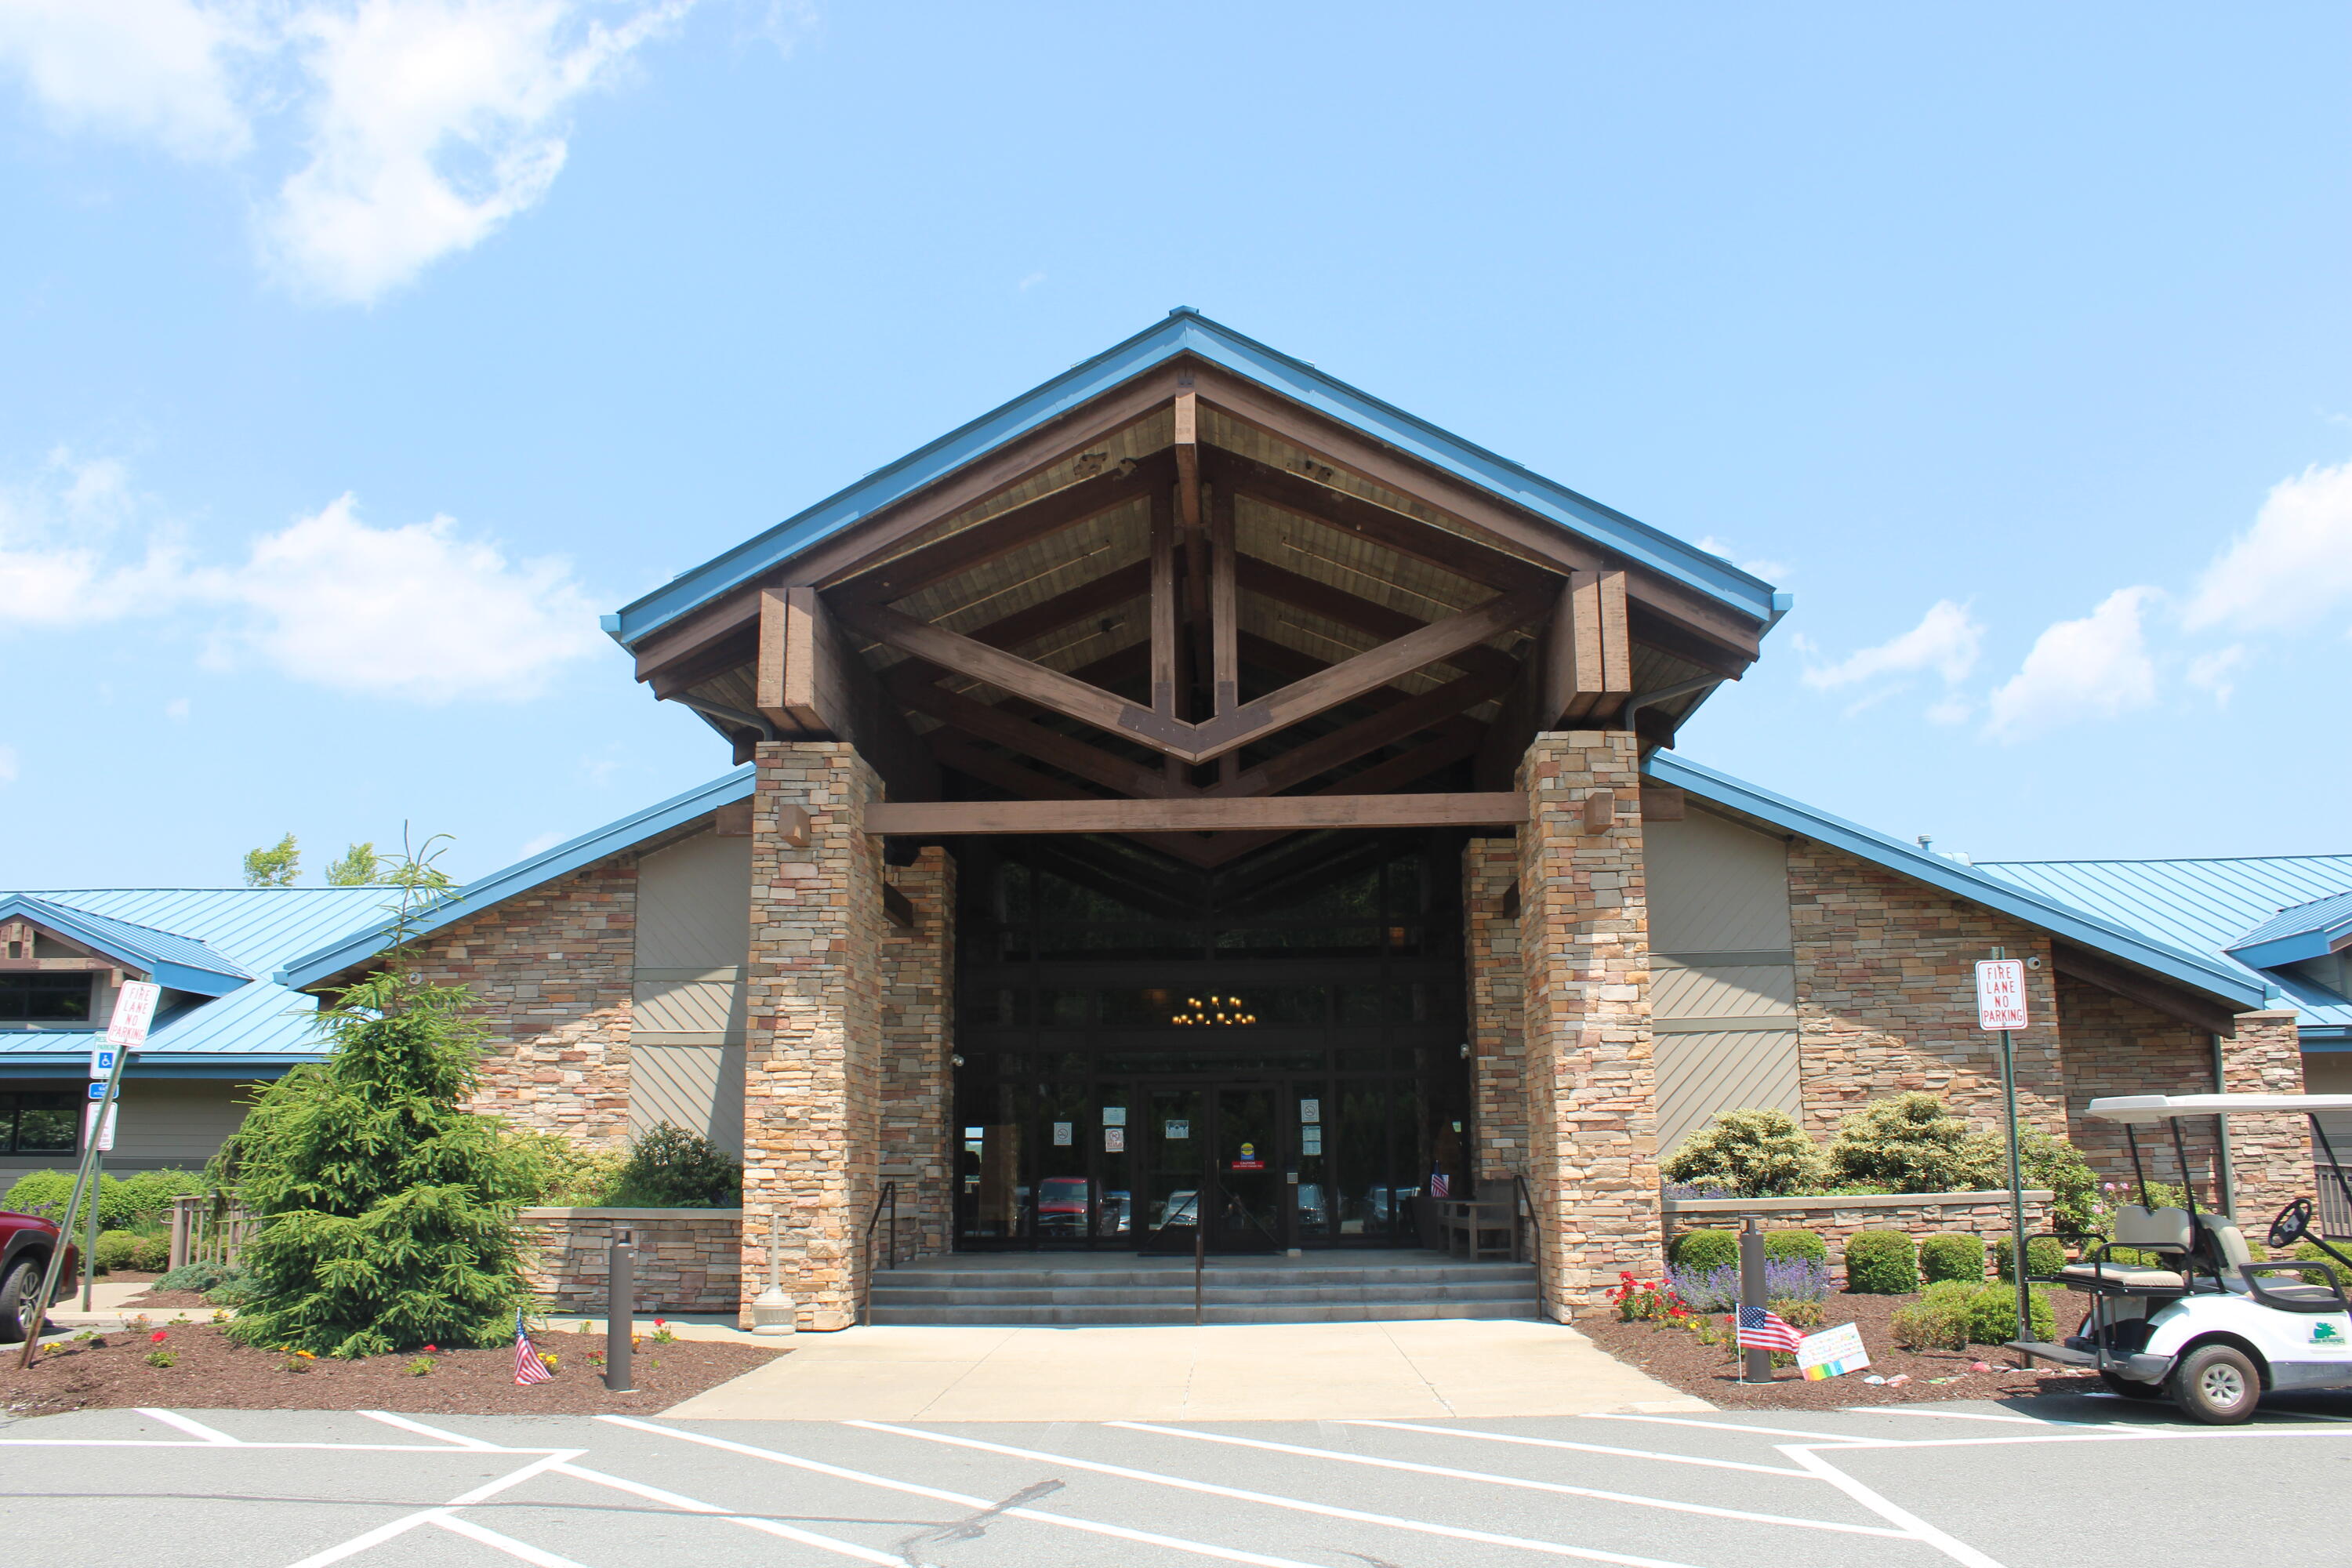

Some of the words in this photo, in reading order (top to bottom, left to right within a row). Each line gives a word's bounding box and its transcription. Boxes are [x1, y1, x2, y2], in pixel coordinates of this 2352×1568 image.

[1987, 967, 2012, 979] FIRE
[1986, 981, 2015, 993] LANE
[129, 988, 151, 1001] FIRE
[123, 1000, 148, 1014] LANE
[1994, 996, 2009, 1007] NO
[125, 1014, 139, 1026] NO
[1983, 1009, 2023, 1022] PARKING
[111, 1025, 144, 1041] PARKING
